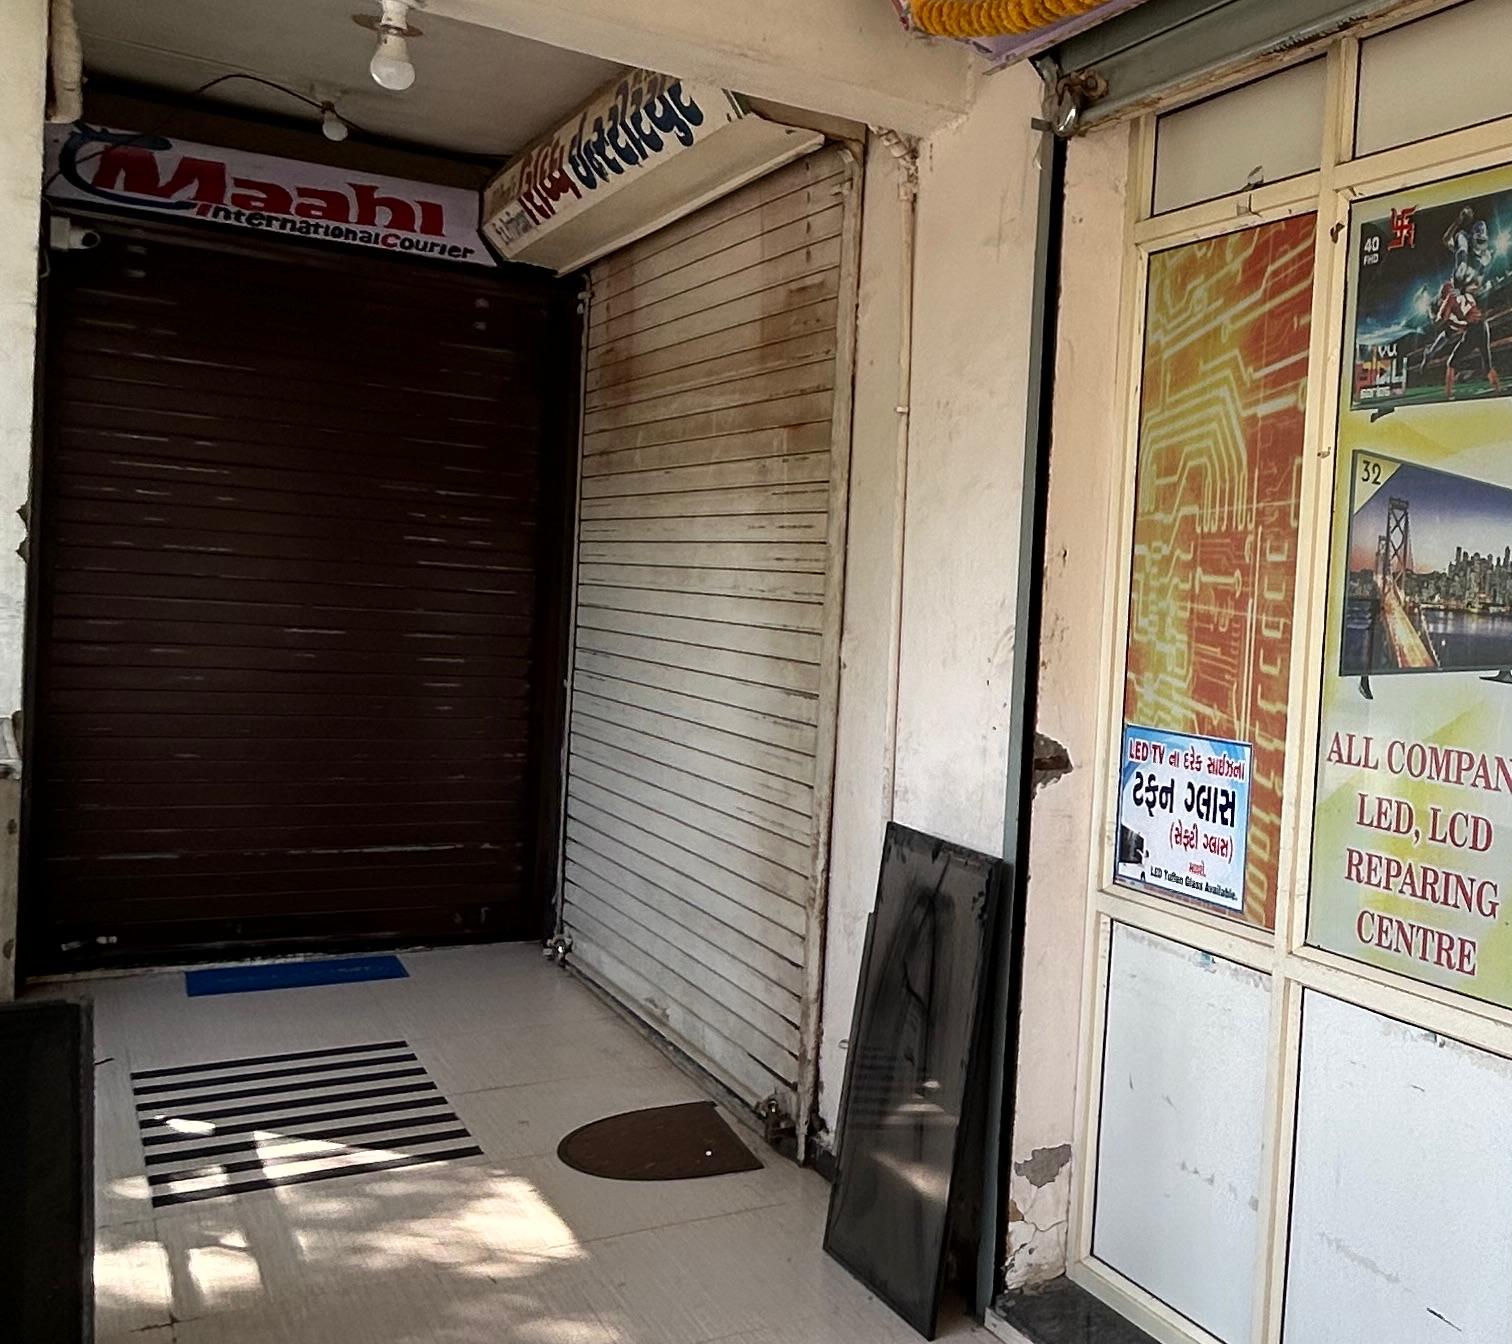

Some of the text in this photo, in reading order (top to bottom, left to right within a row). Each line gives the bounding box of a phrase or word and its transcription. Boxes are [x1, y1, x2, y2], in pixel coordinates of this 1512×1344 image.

[91, 144, 447, 237] Maahi
[1364, 236, 1380, 252] 40
[1364, 254, 1379, 265] FHD
[1360, 459, 1382, 486] 32
[1128, 740, 1149, 762] LED
[1151, 744, 1165, 764] TV
[1326, 731, 1379, 771] ALL
[1132, 771, 1236, 828] ટફન ગ્લાસ
[1356, 792, 1494, 852] LED, LCD
[1150, 865, 1163, 879] LED
[1344, 847, 1500, 919] REPARING
[1356, 909, 1477, 976] CENTRE
